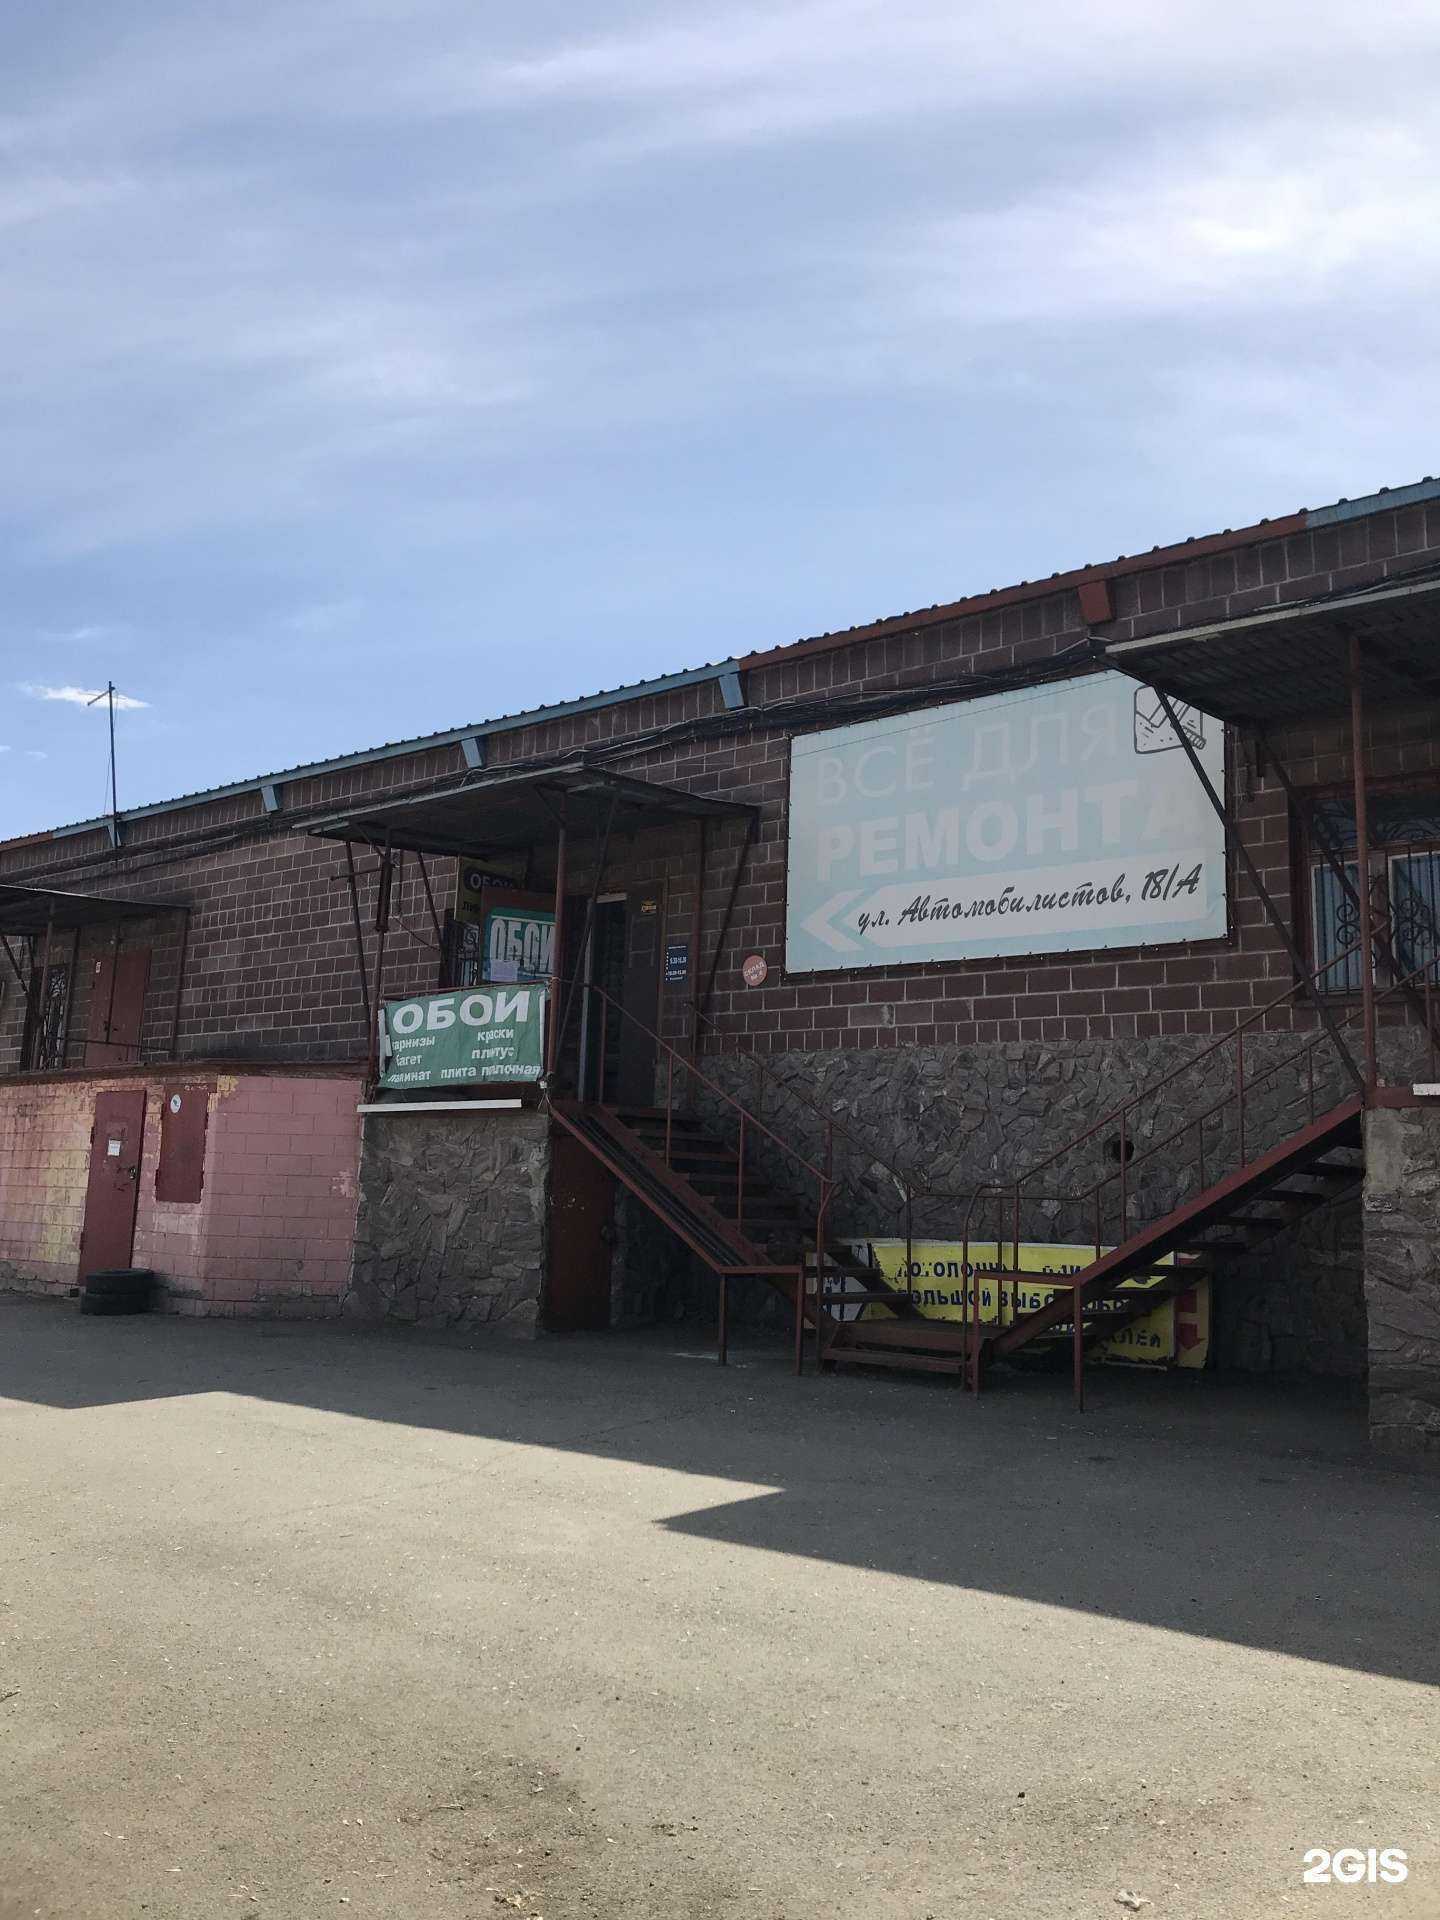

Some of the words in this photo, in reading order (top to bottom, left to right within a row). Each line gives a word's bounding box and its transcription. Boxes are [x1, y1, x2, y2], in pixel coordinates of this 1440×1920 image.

[815, 724, 937, 806] ВСЁ
[961, 702, 1119, 791] ДЛЯ
[815, 776, 1204, 881] РЕМОНТА
[857, 907, 891, 935] ул.
[897, 872, 1132, 926] Автомобилистов,
[392, 990, 531, 1034] ОБОИ
[477, 1027, 514, 1043] краски
[440, 1065, 477, 1079] плита
[898, 1288, 992, 1306] ОЛЬШОЙ
